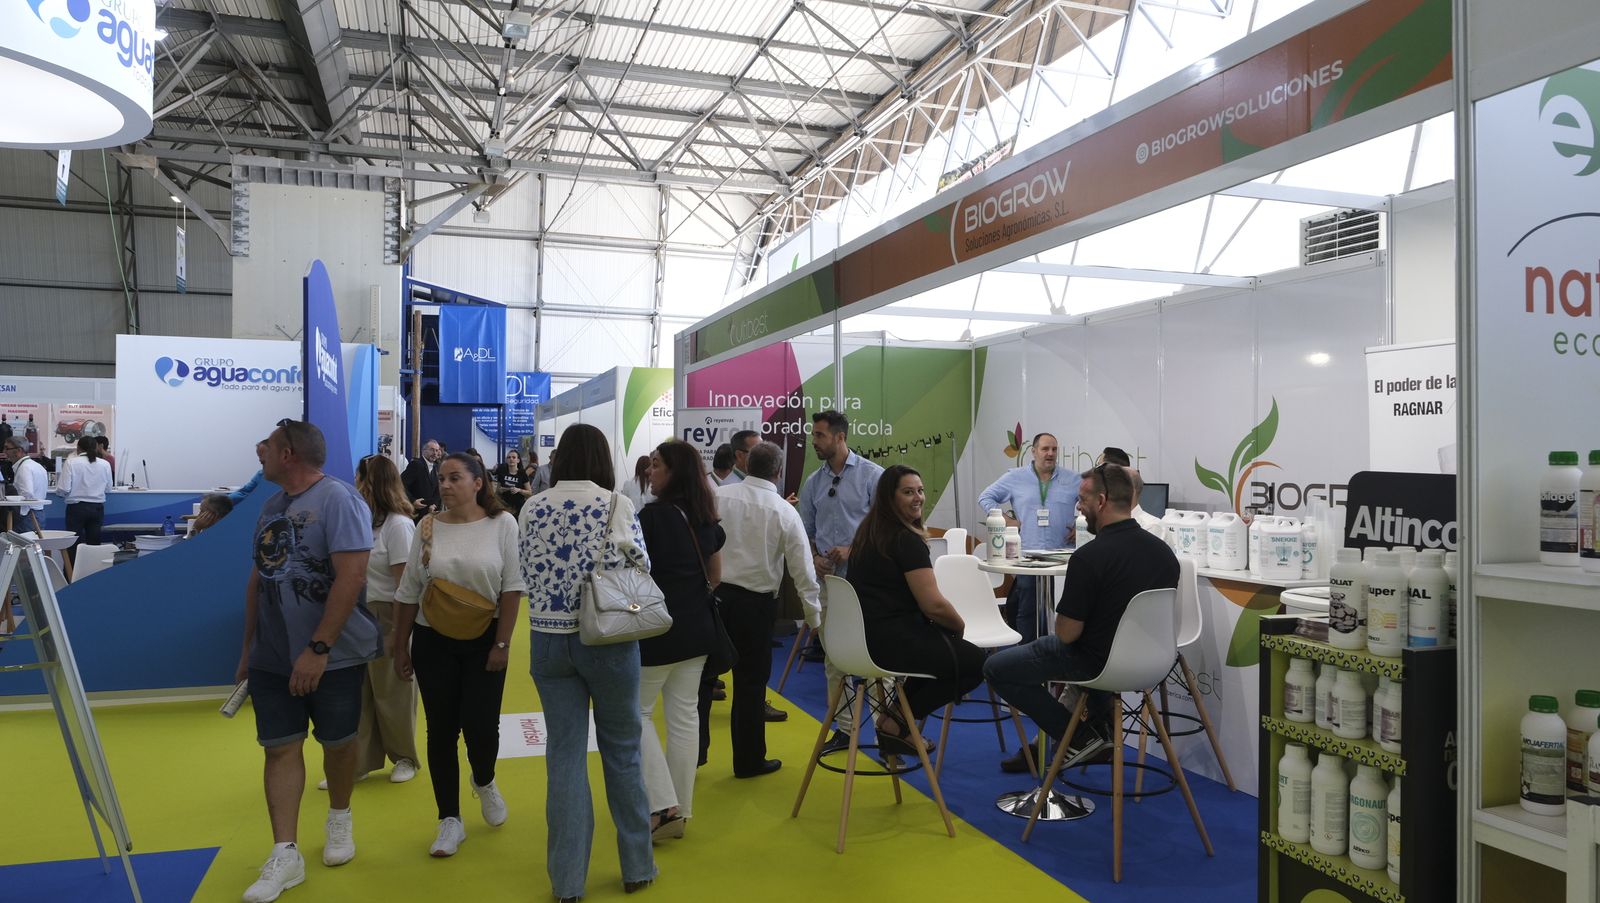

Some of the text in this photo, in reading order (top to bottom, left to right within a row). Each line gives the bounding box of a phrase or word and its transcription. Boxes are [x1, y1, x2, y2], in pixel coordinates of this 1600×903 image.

[1151, 60, 1343, 157] BIOGROWSOLUCIONES
[964, 160, 1071, 233] BIOGROW
[965, 227, 1001, 252] Soluciones
[1054, 202, 1070, 218] S.L.
[194, 357, 234, 367] GRUPO
[1375, 375, 1456, 395] El poder de la
[709, 390, 812, 409] Innovación
[1394, 401, 1443, 416] RAGNAR
[653, 407, 674, 417] Efic
